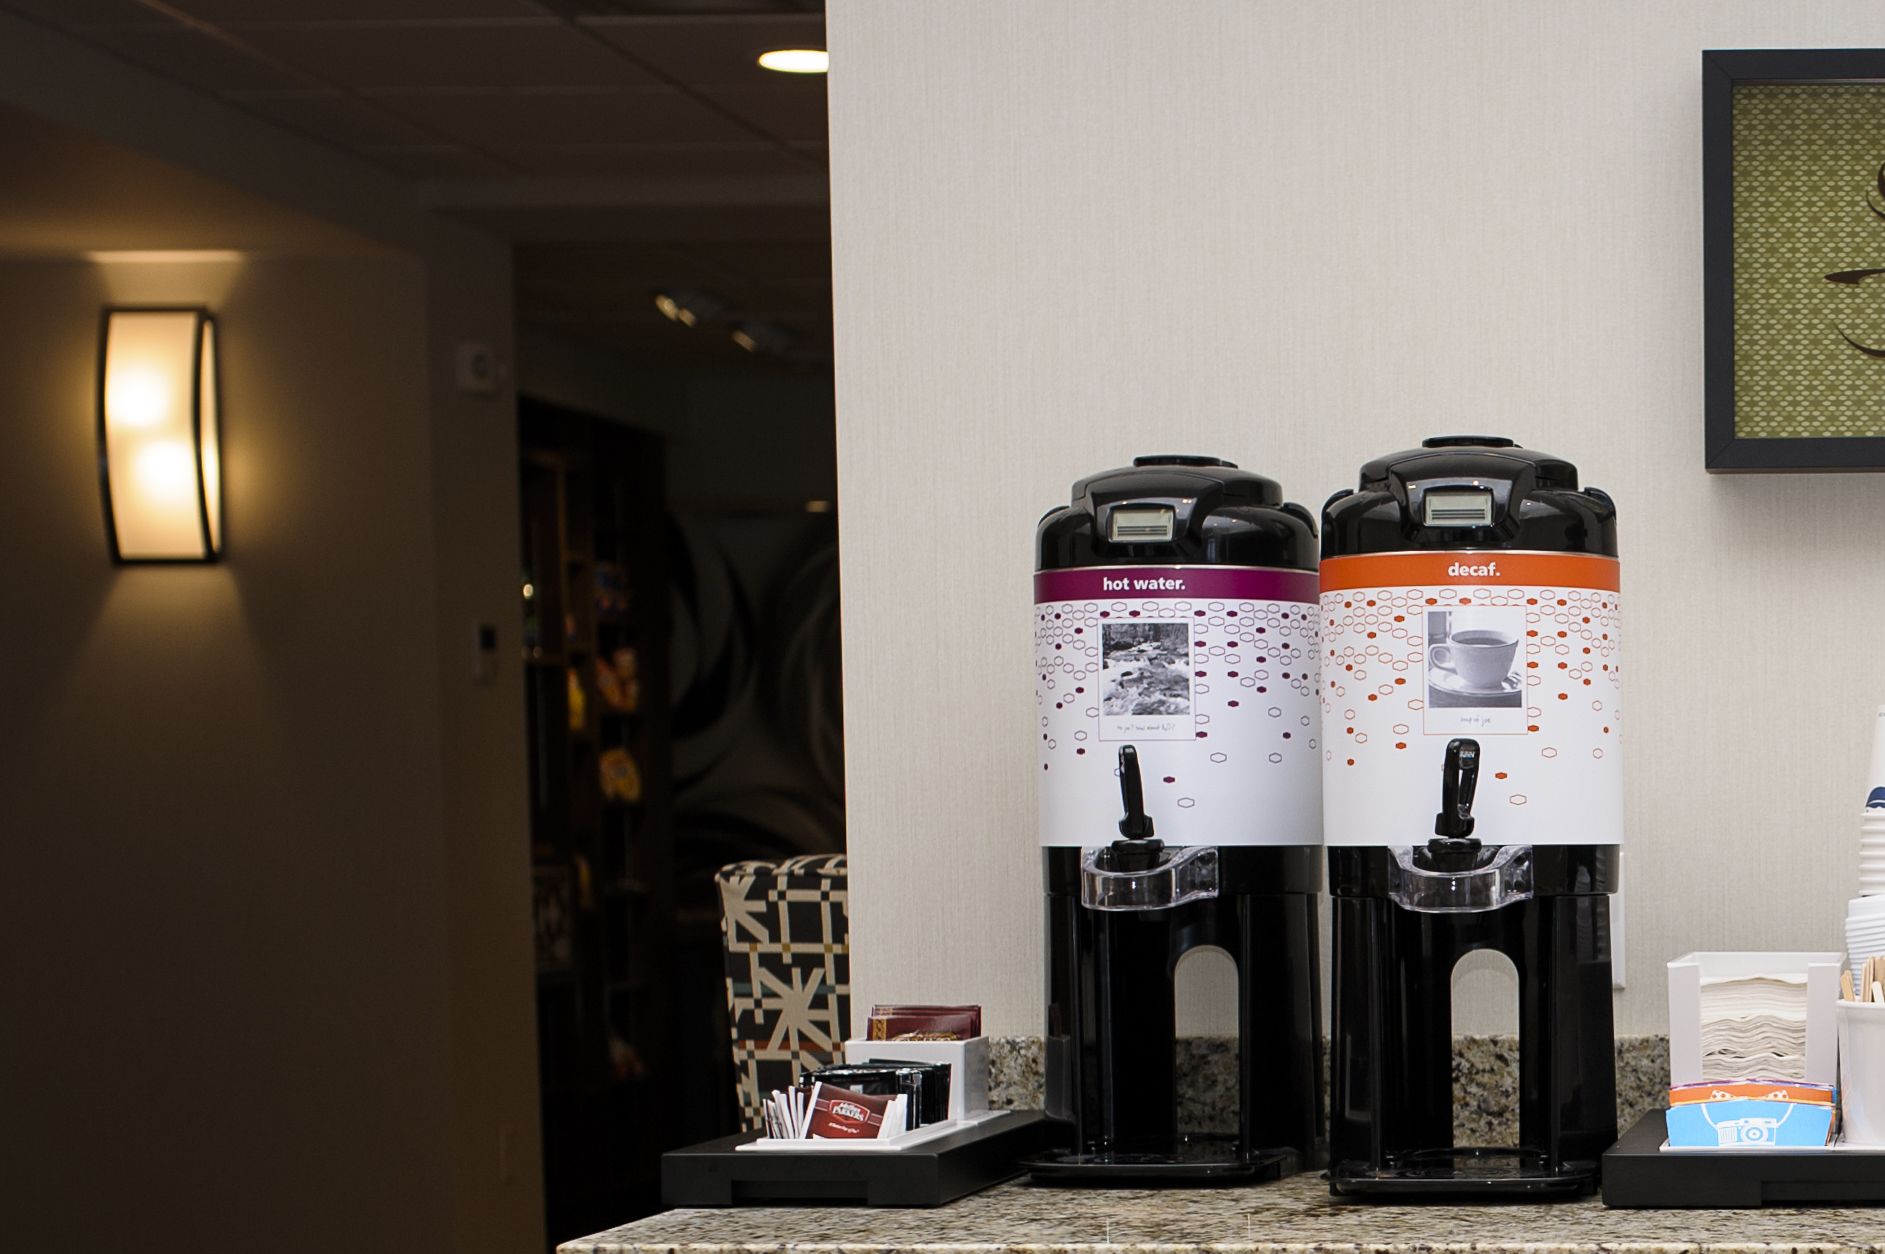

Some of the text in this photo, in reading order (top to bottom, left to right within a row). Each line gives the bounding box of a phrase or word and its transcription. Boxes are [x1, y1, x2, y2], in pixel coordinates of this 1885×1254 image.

[1447, 562, 1501, 577] decaf.
[1103, 577, 1186, 591] hot water.
